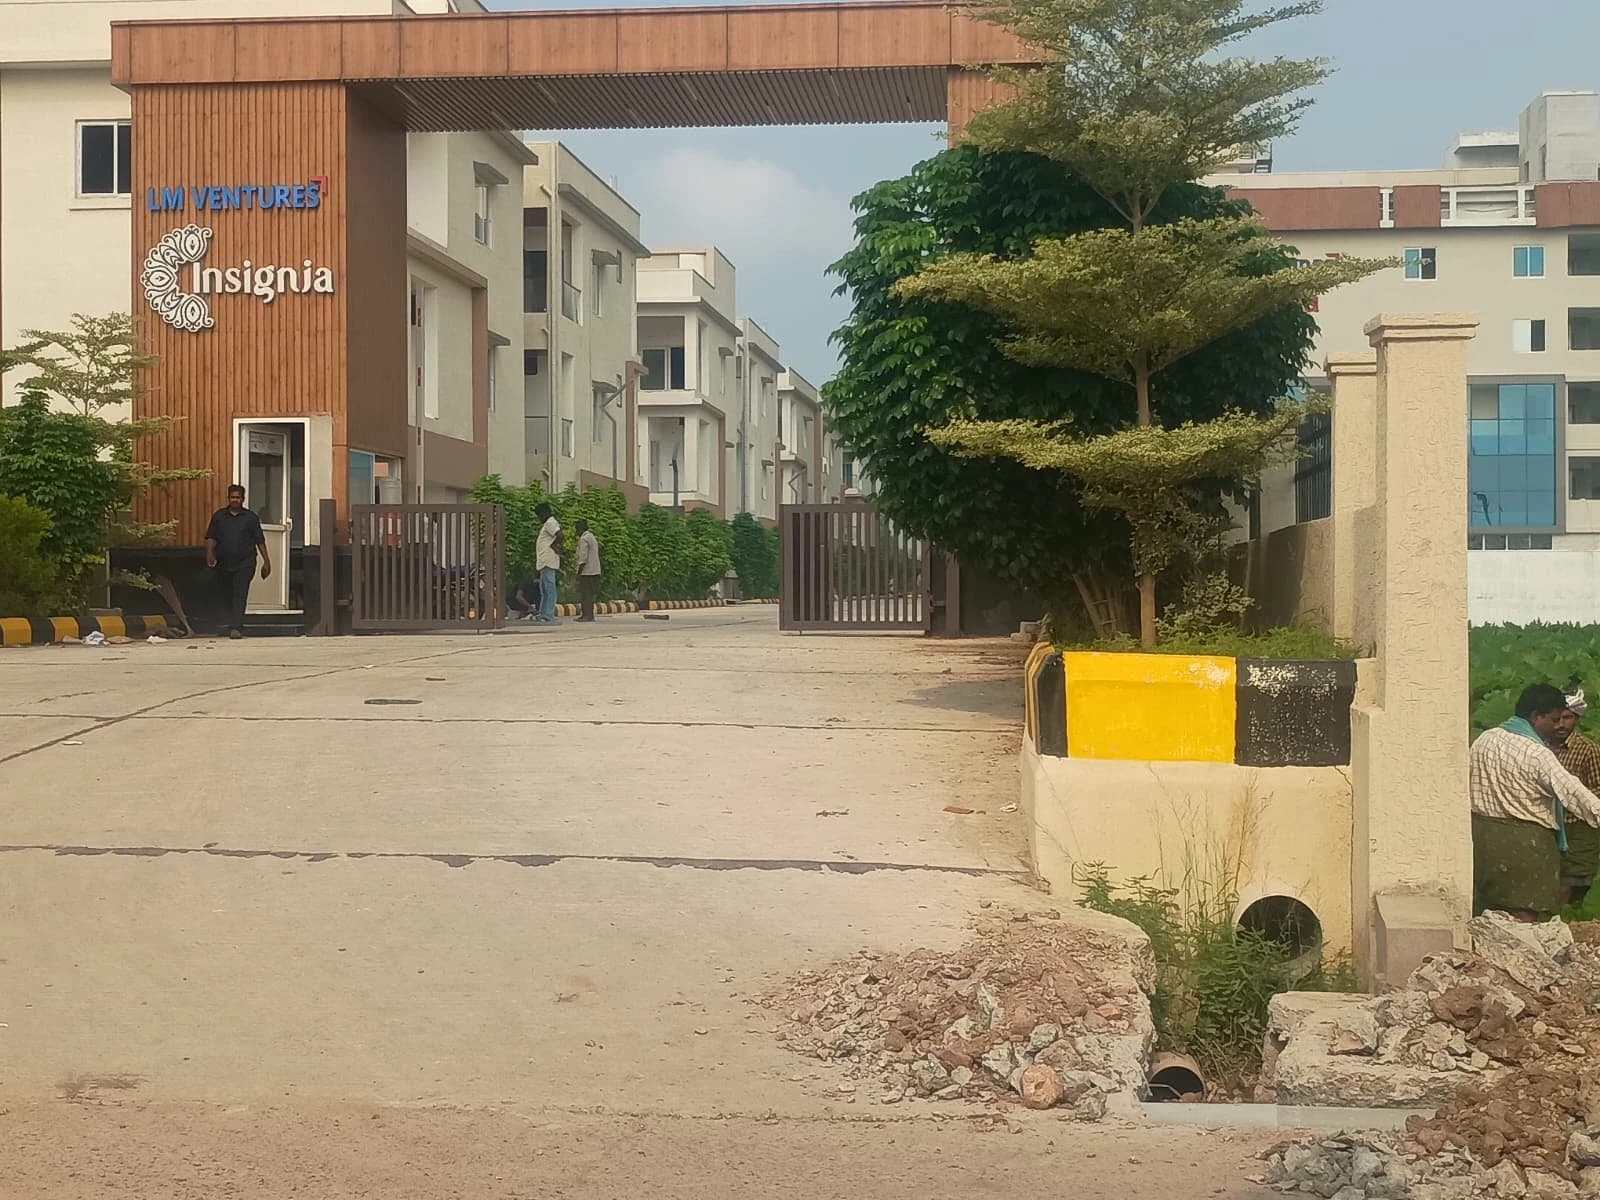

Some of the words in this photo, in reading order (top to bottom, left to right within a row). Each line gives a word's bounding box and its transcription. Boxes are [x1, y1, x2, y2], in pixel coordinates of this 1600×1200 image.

[147, 187, 184, 211] LM
[191, 184, 321, 210] VENTURES
[192, 259, 334, 303] Insignia
